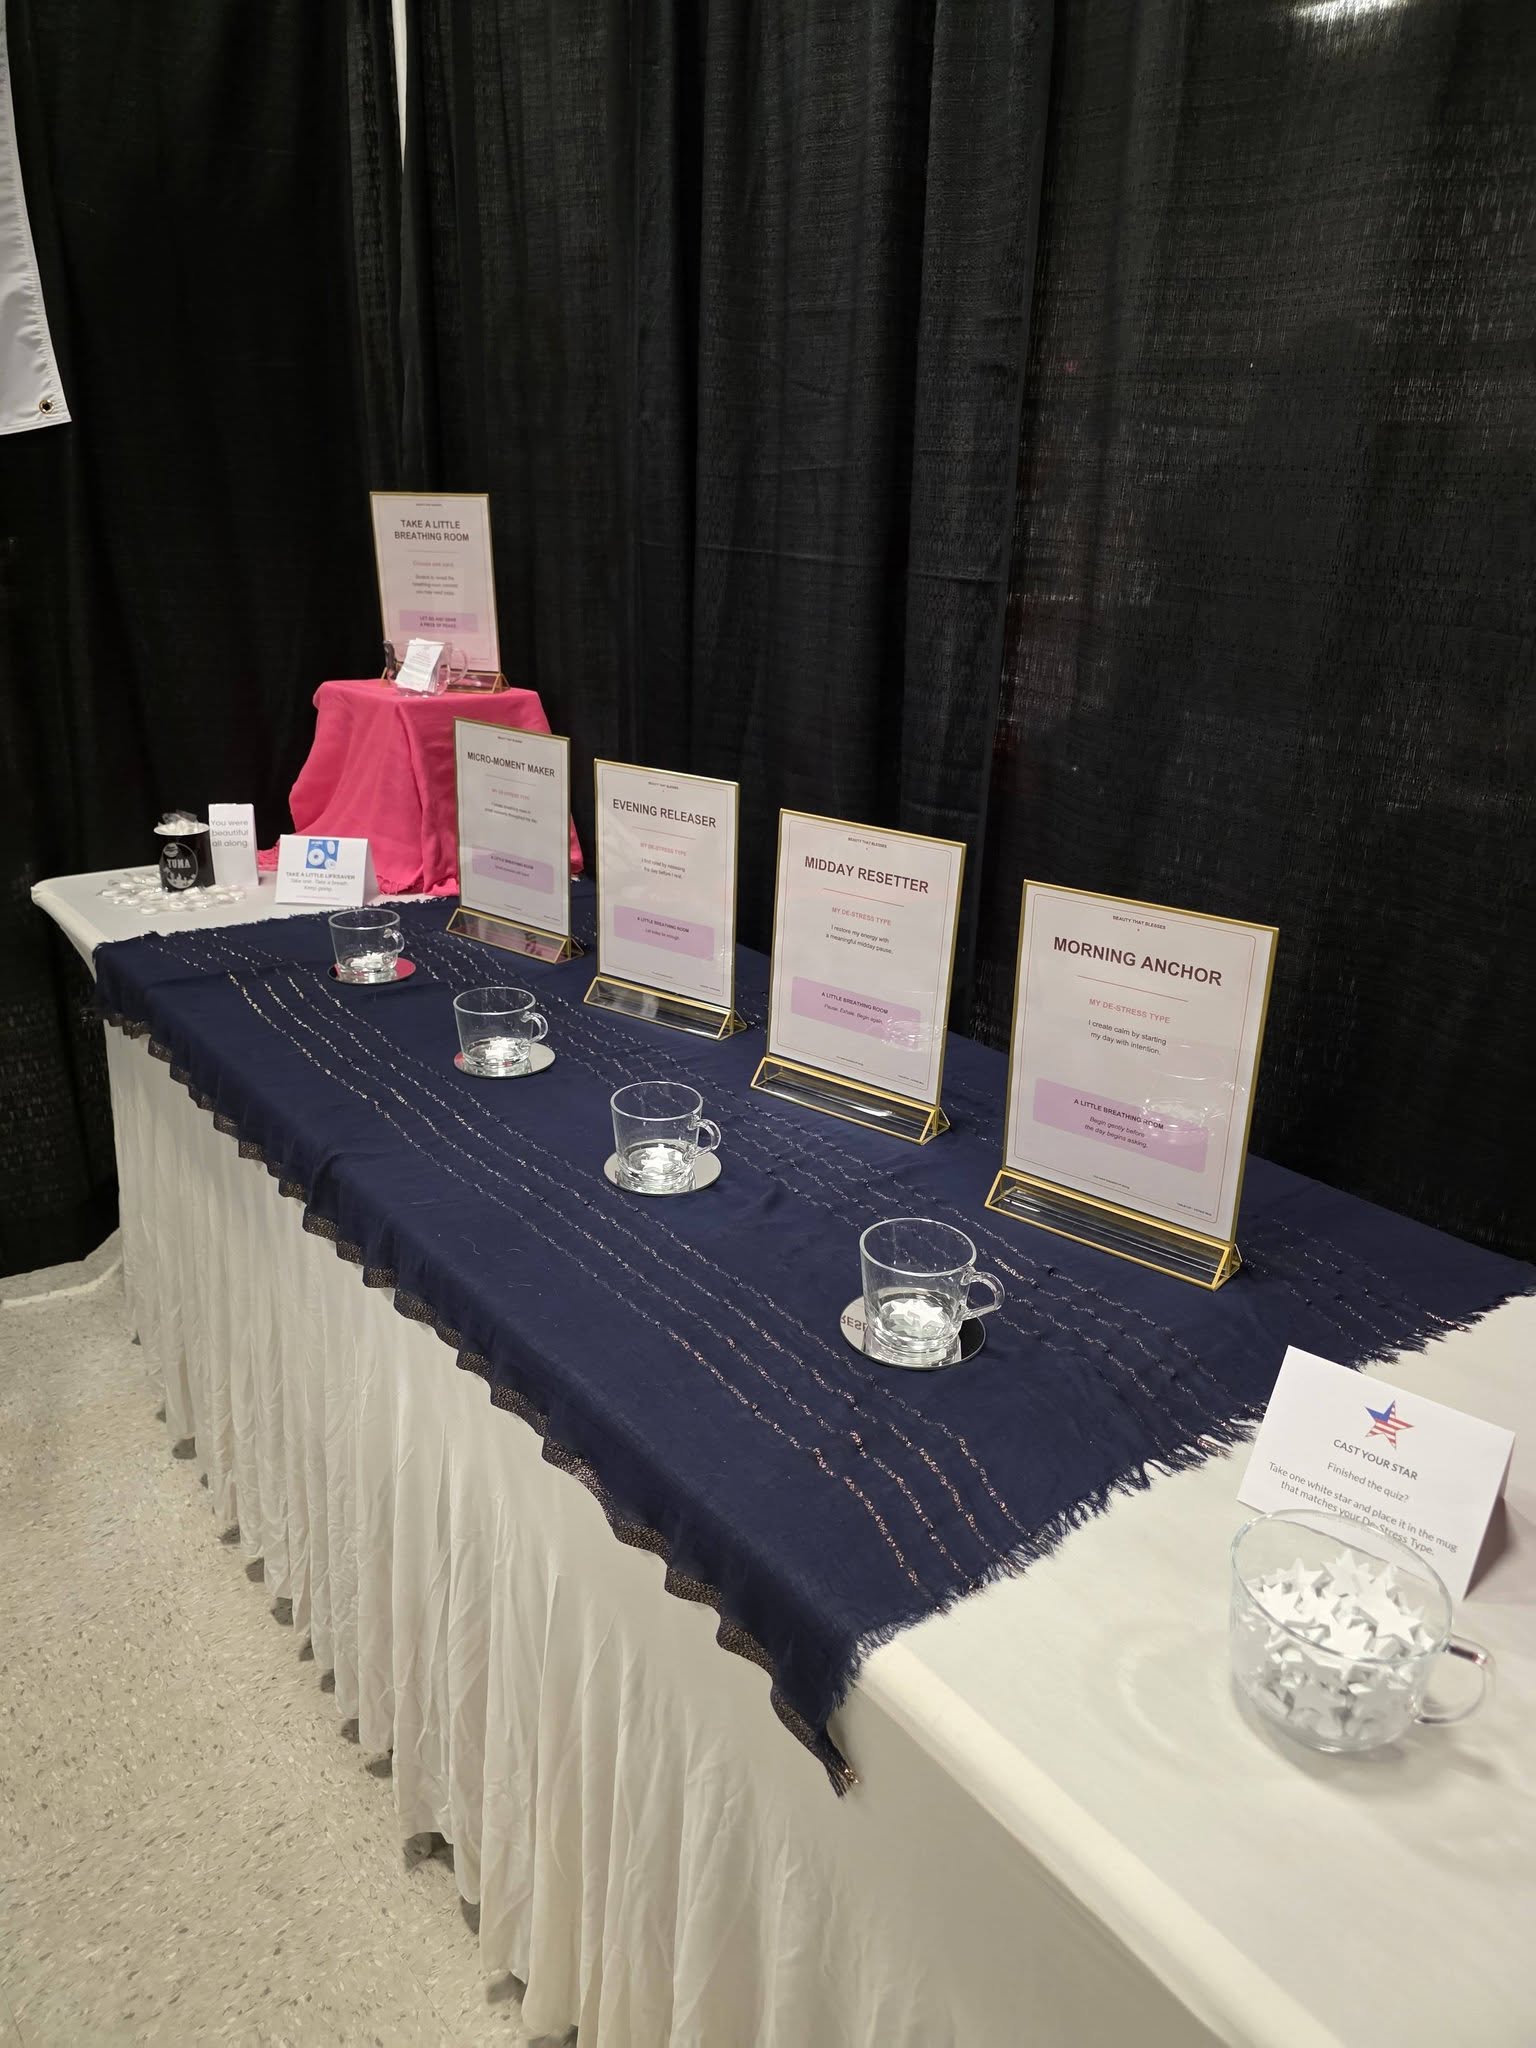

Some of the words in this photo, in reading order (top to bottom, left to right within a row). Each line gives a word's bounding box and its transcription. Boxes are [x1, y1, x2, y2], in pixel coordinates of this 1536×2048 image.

[394, 531, 441, 541] BREATHING
[444, 532, 469, 541] ROOM
[400, 520, 422, 528] TAKE
[425, 520, 431, 528] A
[433, 520, 460, 529] LITTLE
[468, 752, 526, 771] MICRO-MOMENT
[528, 764, 555, 778] MAKER
[613, 798, 657, 816] EVENING
[660, 808, 716, 828] RELEASER
[805, 856, 854, 877] MIDDAY
[858, 867, 928, 894] RESETTER
[842, 909, 874, 922] DE-STRESS
[876, 917, 892, 926] TYPE
[1112, 915, 1131, 923] BEAUTY
[1145, 921, 1166, 930] BLESSES
[830, 934, 856, 945] meaningful
[857, 940, 876, 950] midday
[834, 926, 851, 934] restore
[861, 932, 878, 942] energy
[1054, 936, 1136, 967] MORNING
[1140, 956, 1222, 987] ANCHOR
[826, 993, 842, 1002] LITTLE
[843, 997, 872, 1010] BREATHING
[872, 1006, 888, 1014] ROOM
[1089, 998, 1100, 1006] MY
[1102, 1001, 1147, 1018] DE-STRESS
[1150, 1012, 1171, 1024] TYPE
[1090, 1032, 1101, 1041] my
[1102, 1033, 1114, 1044] day
[1116, 1038, 1129, 1047] with
[1131, 1041, 1161, 1055] intention.
[1092, 1021, 1113, 1032] create
[1114, 1025, 1130, 1036] calm
[1132, 1030, 1140, 1039] by
[1142, 1032, 1167, 1046] starting
[1080, 1100, 1102, 1112] LITTLE
[1103, 1106, 1142, 1123] BREATHING
[1143, 1119, 1164, 1130] ROOM
[1090, 1116, 1106, 1127] Begin
[1107, 1122, 1125, 1132] gently
[1126, 1127, 1145, 1138] before
[1095, 1127, 1106, 1135] day
[1107, 1130, 1126, 1142] begins
[1127, 1137, 1148, 1148] asking.
[1333, 1439, 1360, 1456] CAST
[1362, 1448, 1392, 1470] YOUR
[1391, 1462, 1418, 1480] STAR
[1327, 1462, 1366, 1486] Finished
[1367, 1480, 1383, 1493] the
[1383, 1488, 1409, 1504] quiz?
[1269, 1462, 1288, 1477] Take
[1289, 1472, 1306, 1485] one
[1307, 1479, 1333, 1497] white
[1334, 1490, 1352, 1505] star
[1353, 1500, 1372, 1514] and
[1372, 1507, 1398, 1526] place
[1398, 1520, 1406, 1530] it
[1407, 1523, 1416, 1534] in
[1419, 1528, 1435, 1542] the
[1436, 1538, 1457, 1553] mug
[1281, 1480, 1299, 1496] that
[1300, 1489, 1337, 1512] matches
[1339, 1507, 1361, 1522] your
[1362, 1516, 1408, 1544] De-Stress
[1410, 1534, 1434, 1556] Type.
